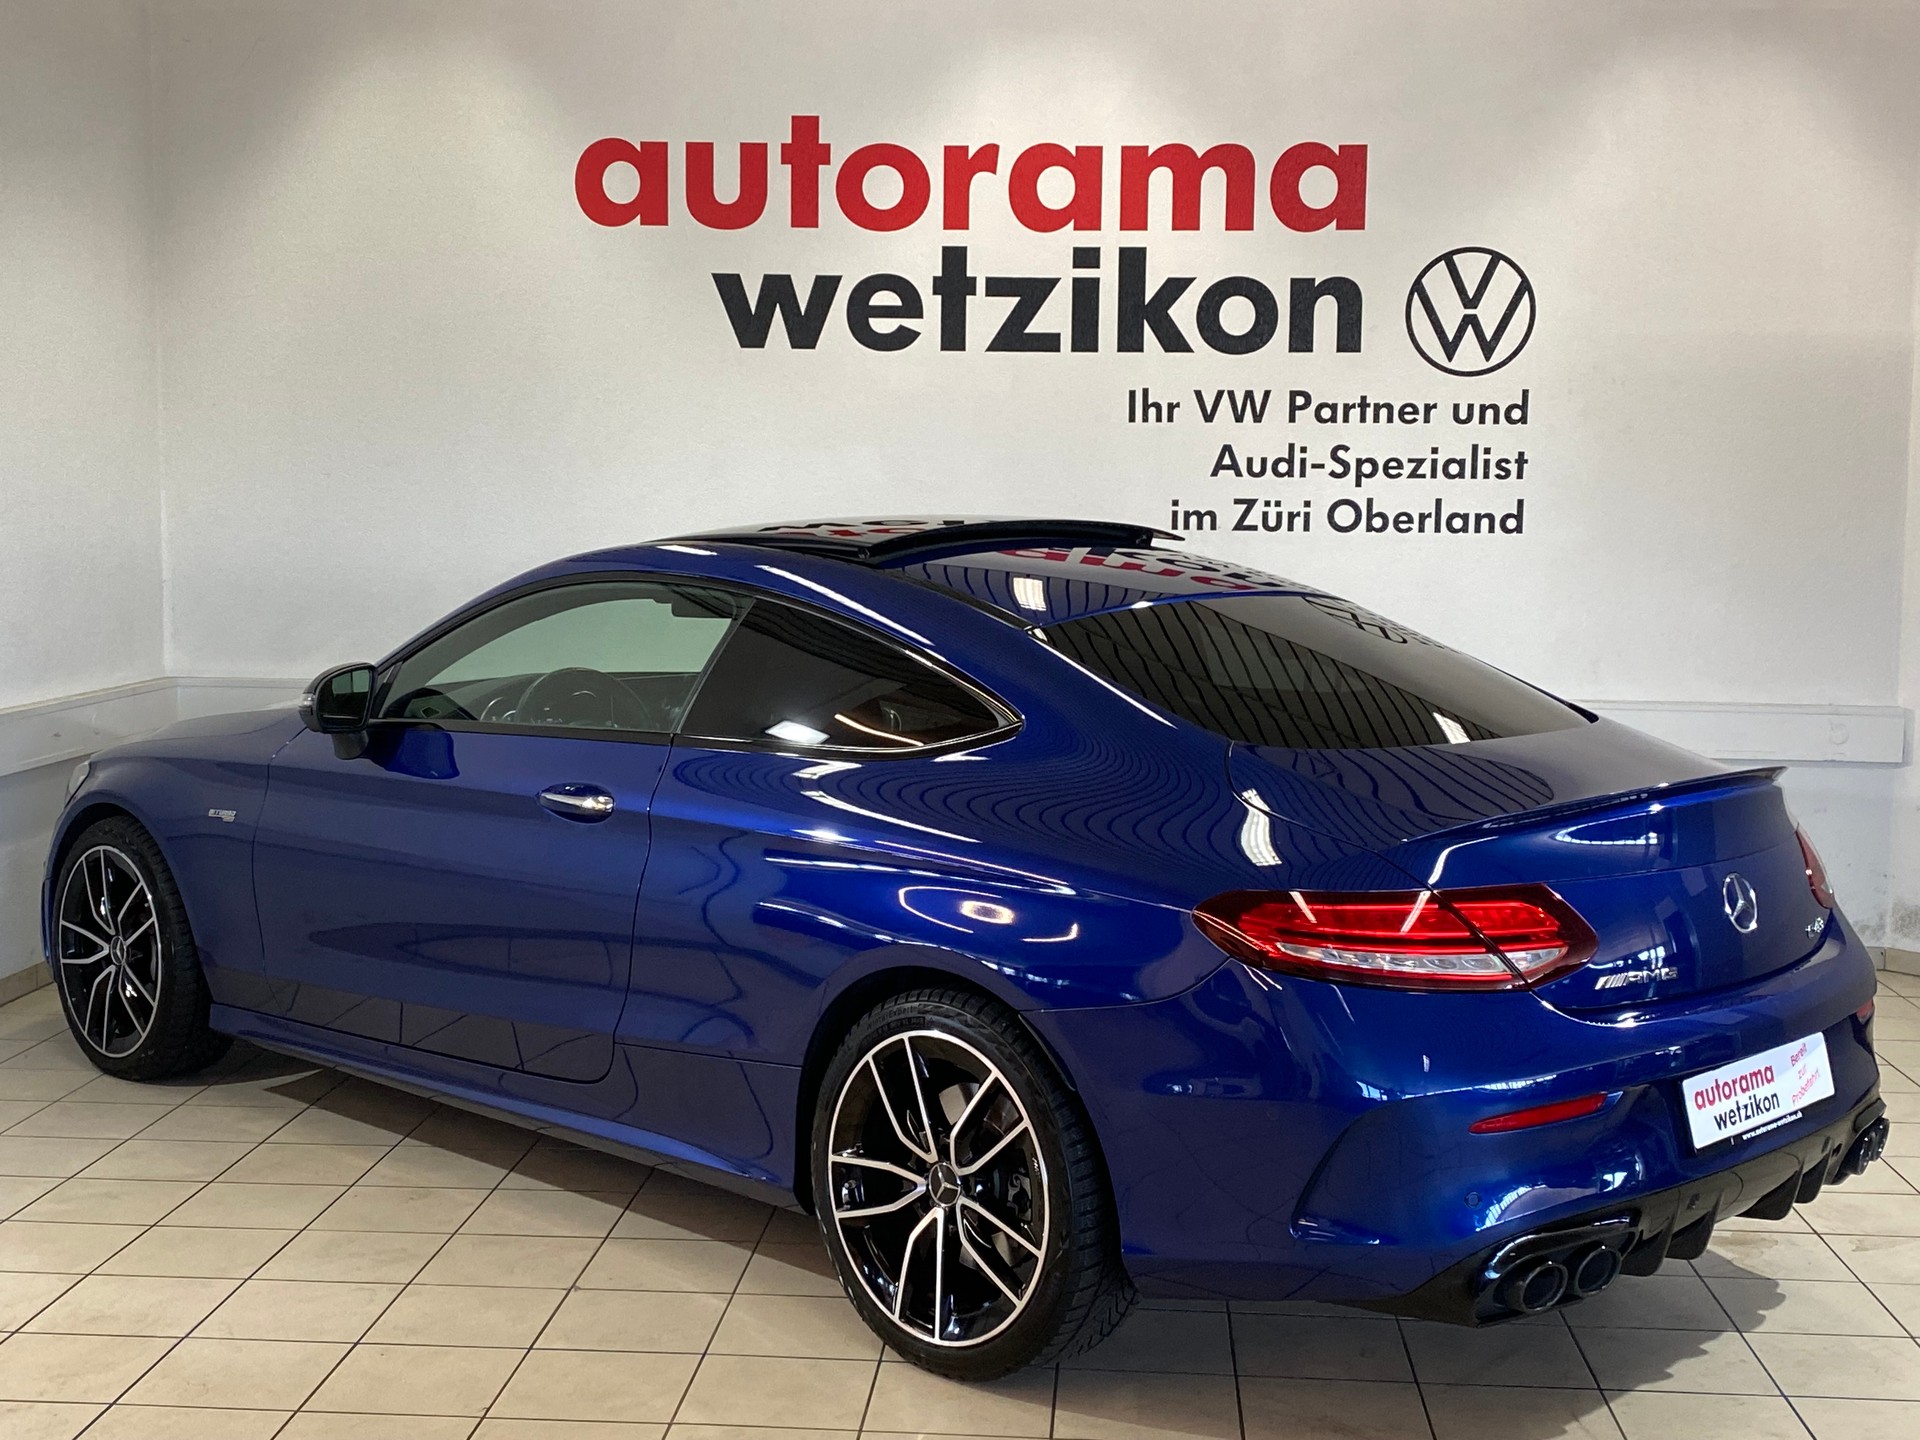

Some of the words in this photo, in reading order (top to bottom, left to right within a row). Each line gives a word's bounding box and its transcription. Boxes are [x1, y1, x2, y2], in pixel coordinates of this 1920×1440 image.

[575, 116, 1368, 232] autorama
[711, 246, 1363, 355] wetzikon
[1129, 388, 1181, 423] Ihr
[1194, 390, 1272, 423] VW
[1289, 390, 1438, 424] Partner
[1453, 389, 1530, 425] und
[1210, 443, 1529, 487] Audi-Spezialist
[1171, 499, 1217, 532] im
[1232, 498, 1311, 533] Züri
[1328, 498, 1524, 534] Oberland
[1694, 1065, 1775, 1110] autorama
[1714, 1093, 1781, 1131] wetzikon
